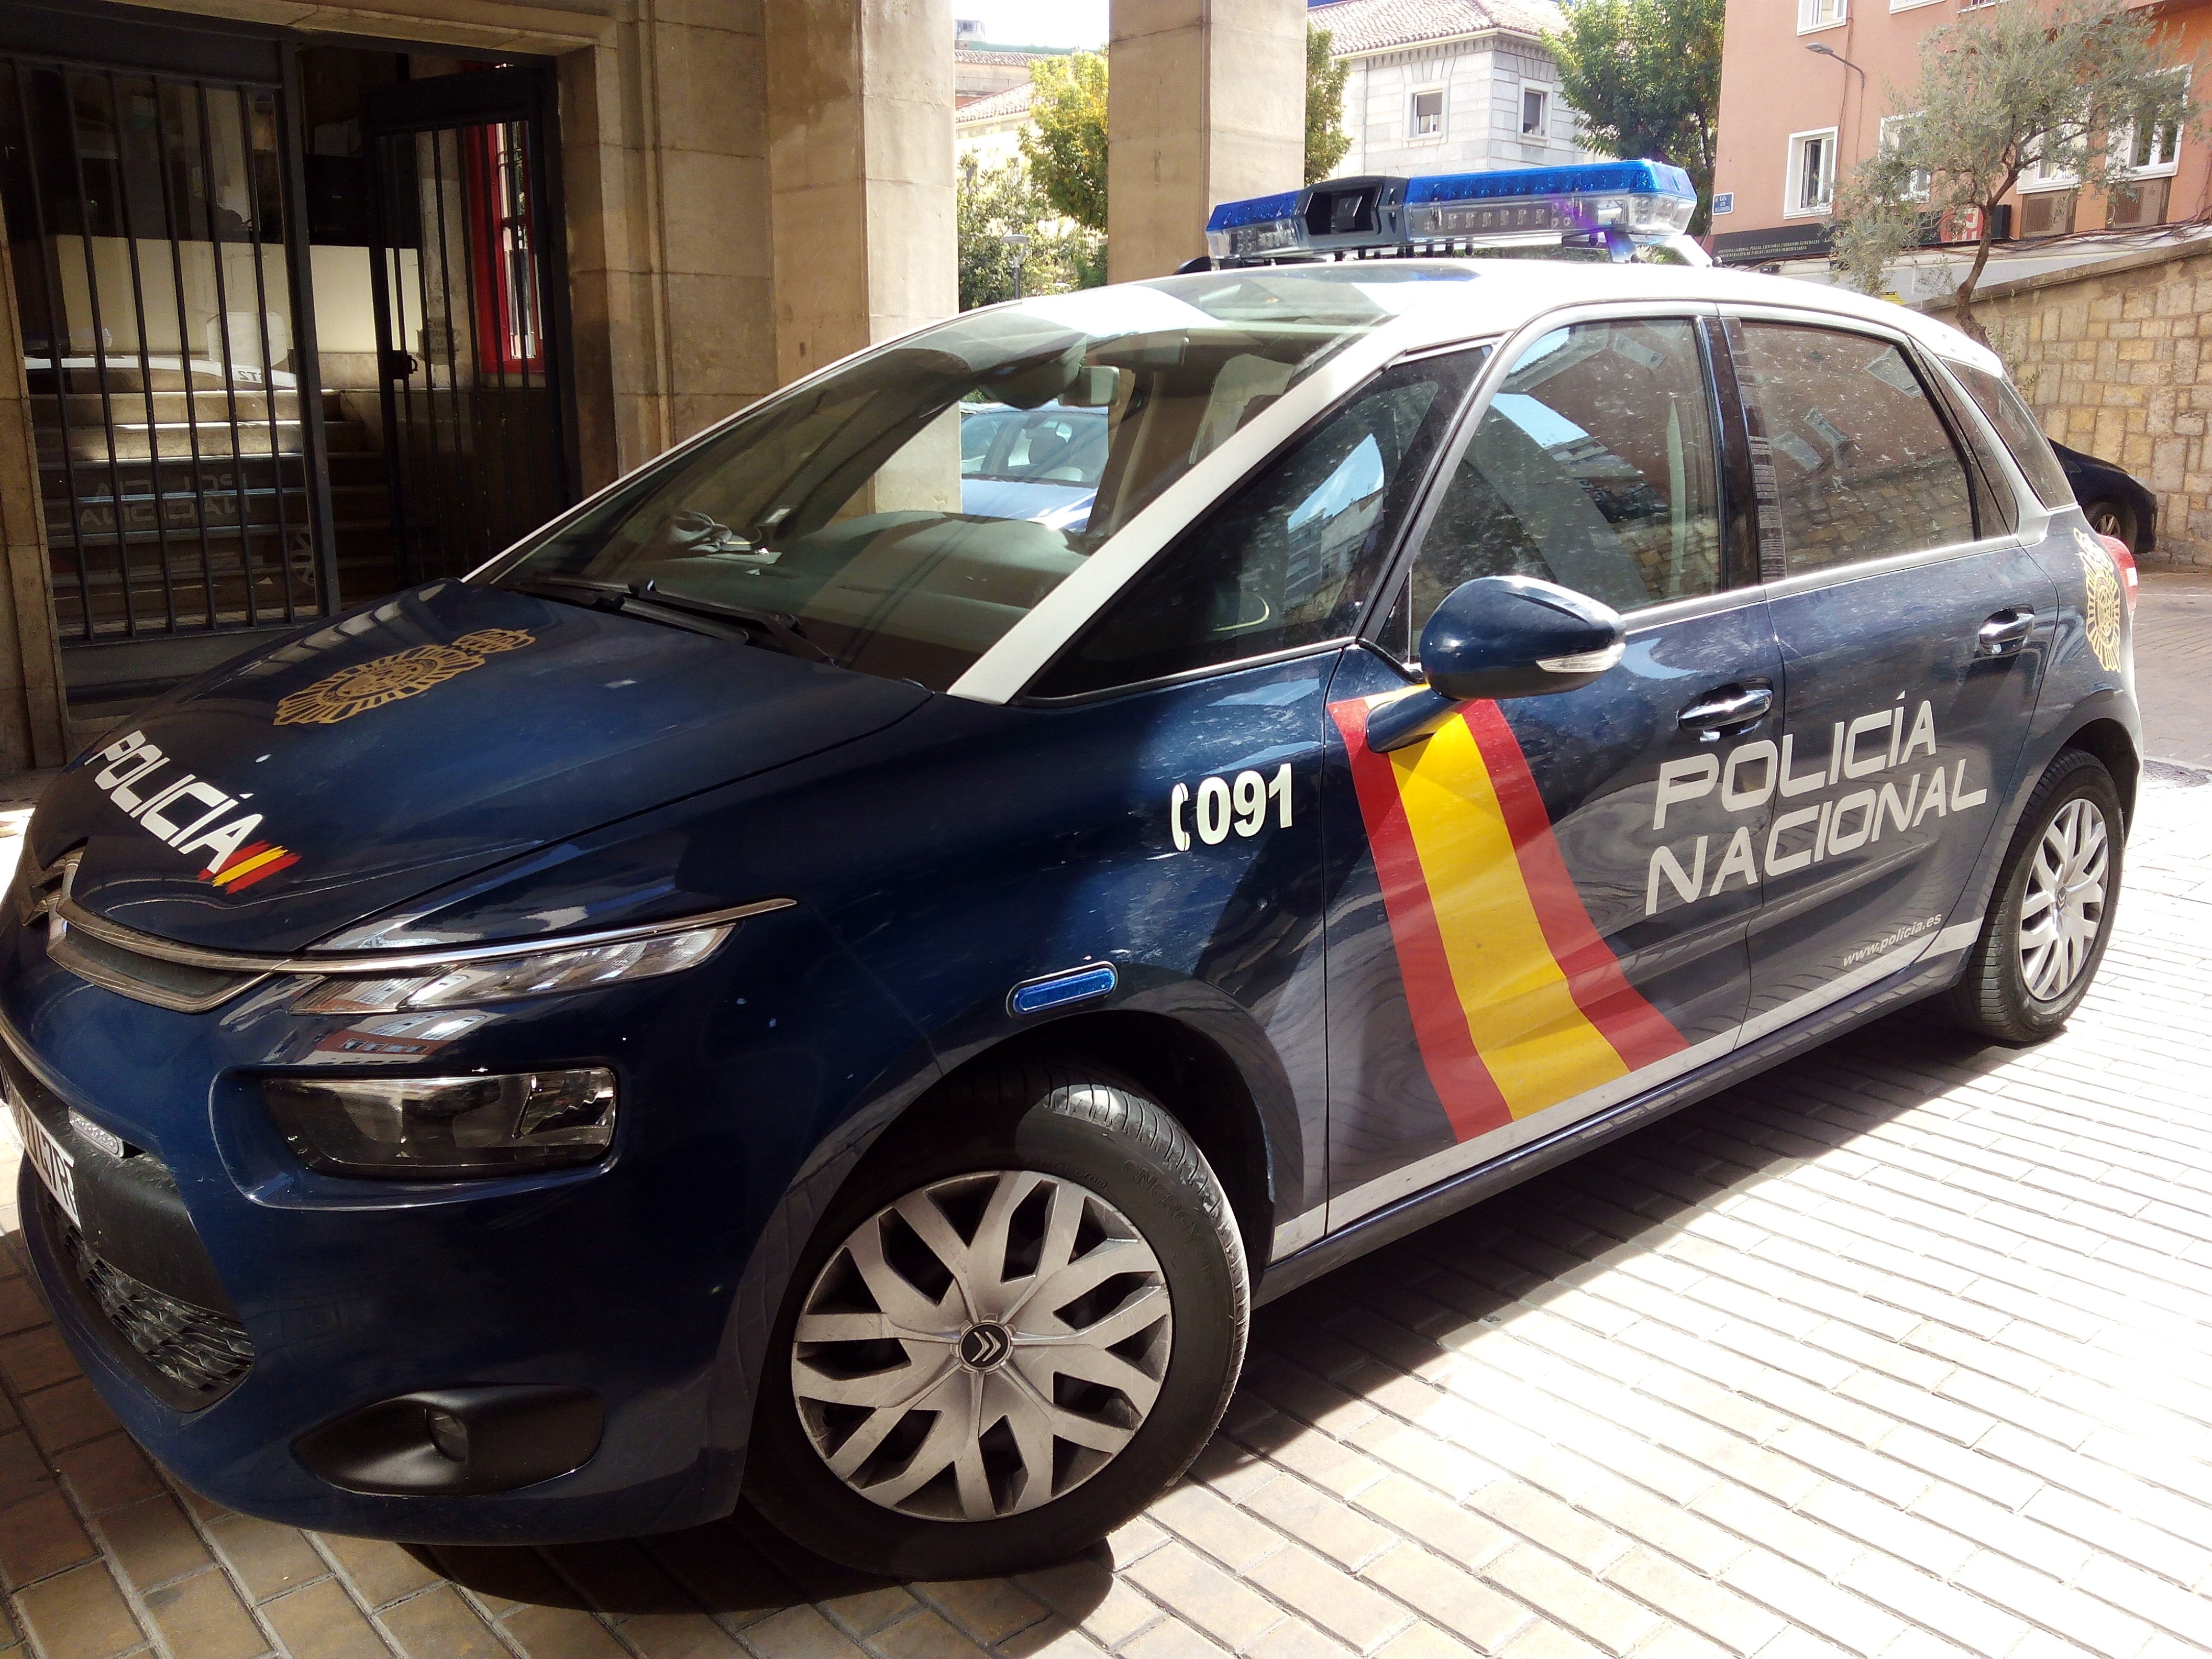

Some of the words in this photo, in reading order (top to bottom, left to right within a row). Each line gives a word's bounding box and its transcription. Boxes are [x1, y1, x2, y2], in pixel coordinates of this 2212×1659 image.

[84, 730, 263, 874] POLICÍA
[1196, 763, 1292, 845] 091
[1652, 690, 1936, 831] POLICÍA
[1645, 758, 1987, 916] NACIONAL
[1843, 913, 1942, 967] www.policia.es
